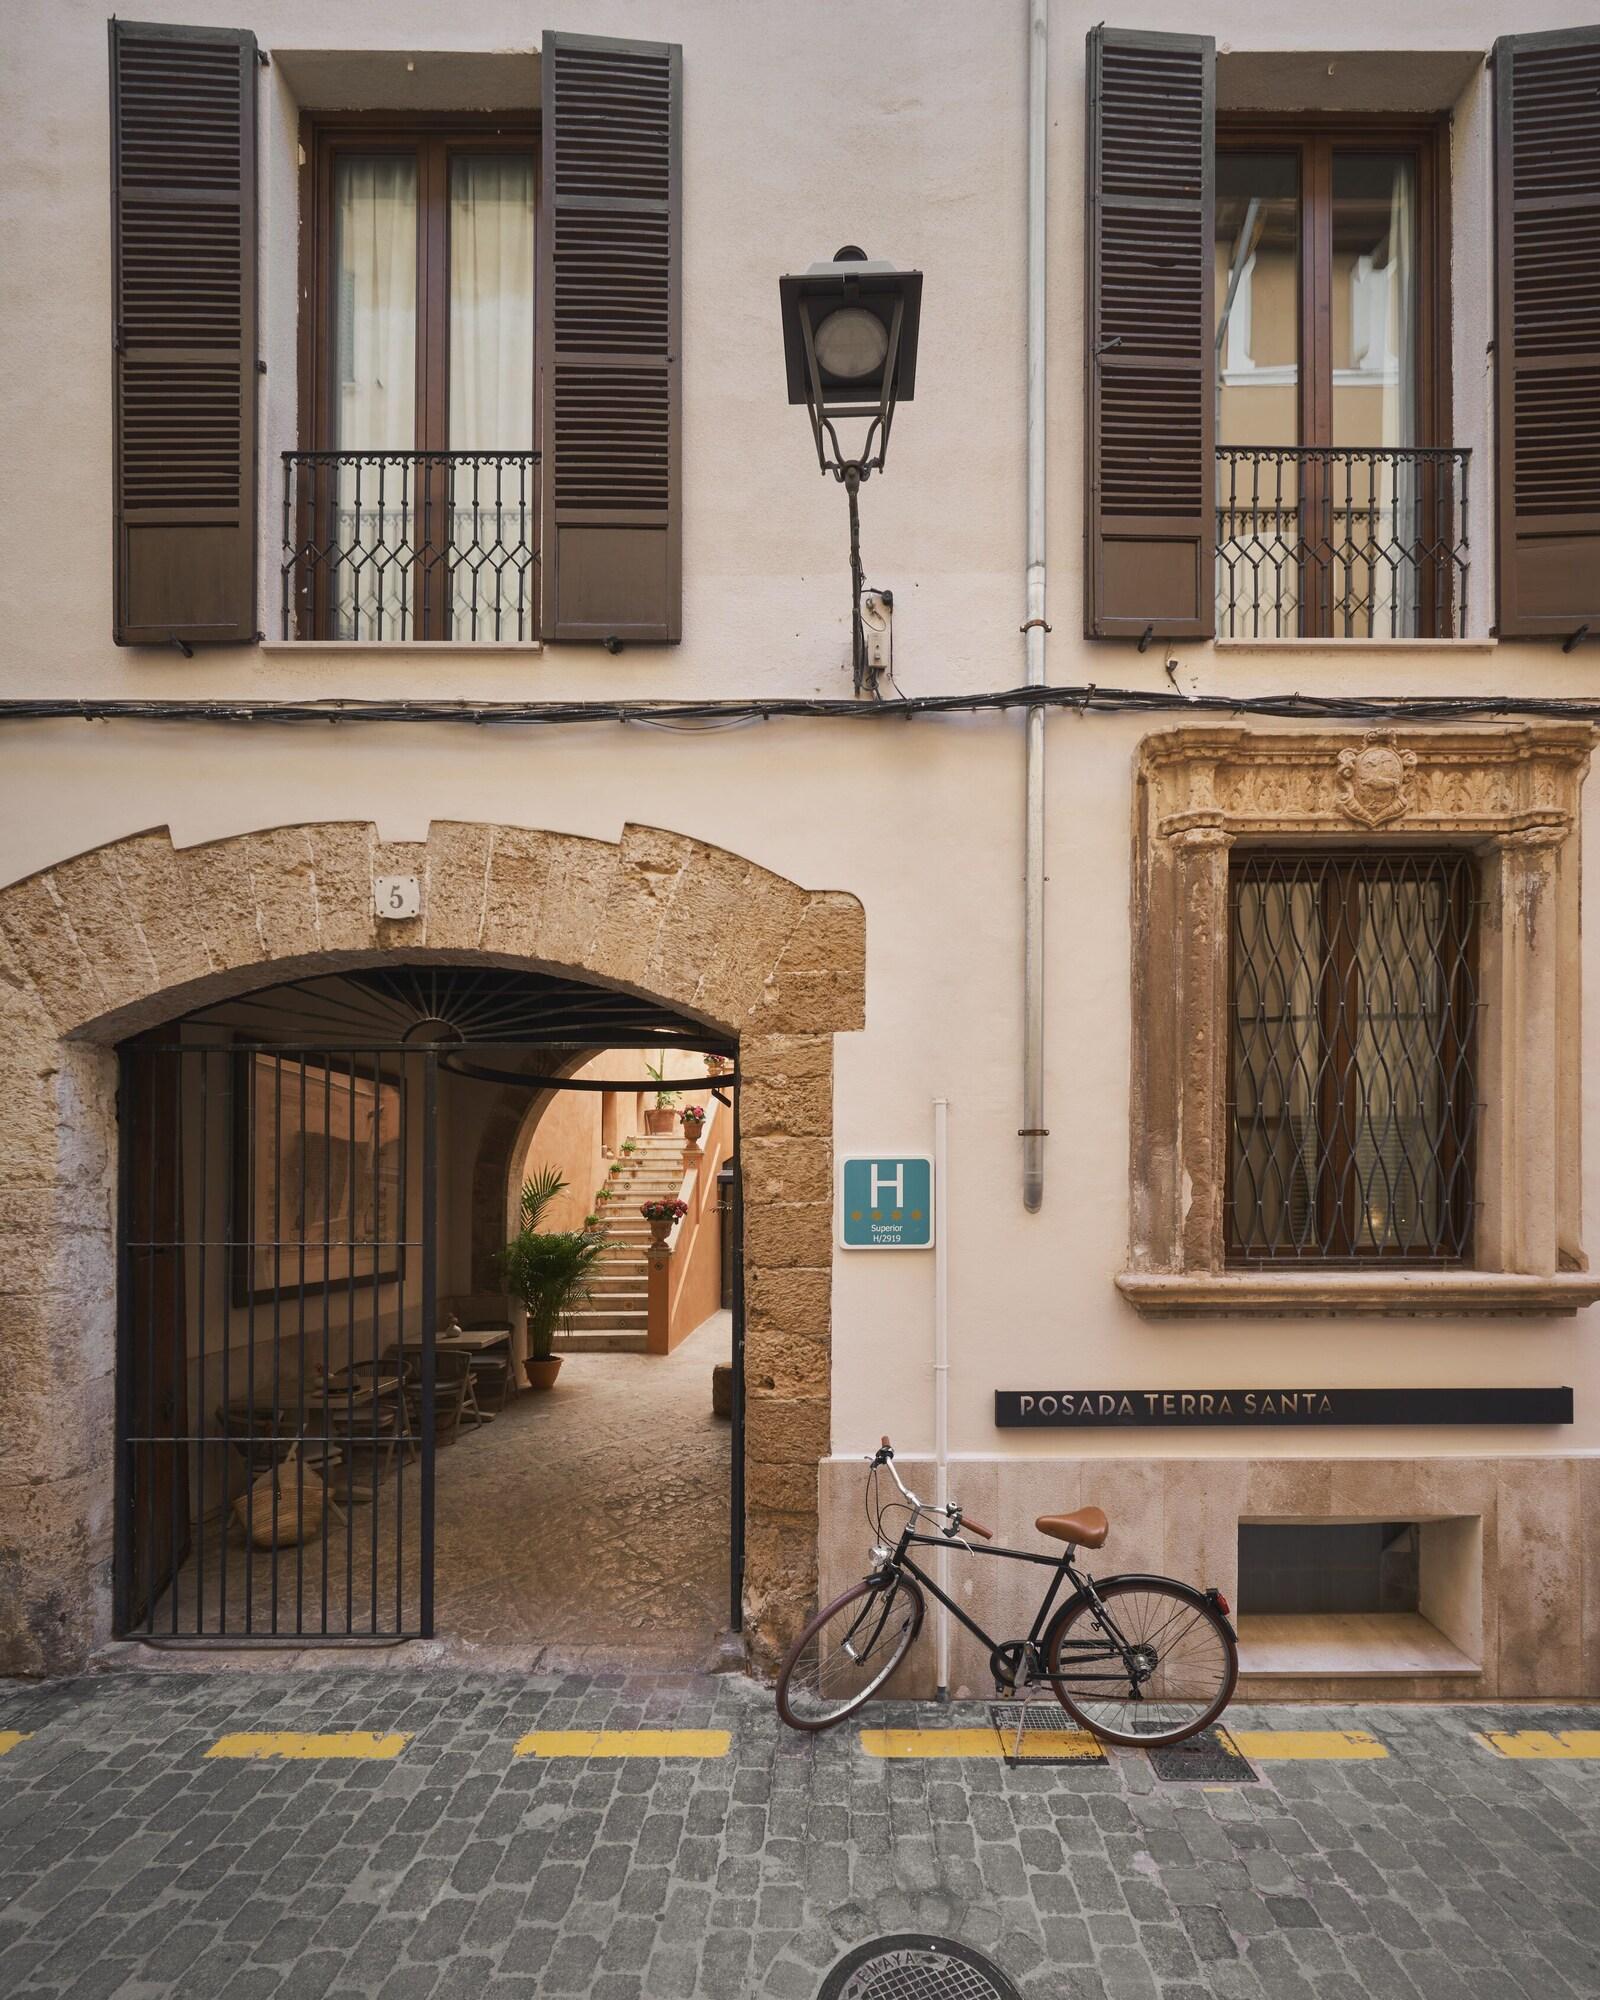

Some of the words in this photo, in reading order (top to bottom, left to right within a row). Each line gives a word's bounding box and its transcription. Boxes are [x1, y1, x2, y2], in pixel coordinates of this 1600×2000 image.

[390, 885, 403, 909] 5
[871, 1164, 903, 1208] H
[871, 1224, 903, 1233] Superior
[873, 1234, 901, 1243] H/2919
[1020, 1394, 1135, 1416] POSADA
[1144, 1393, 1234, 1415] TERRA
[1244, 1393, 1334, 1415] SANTA
[857, 1951, 916, 1983] EMAYA
